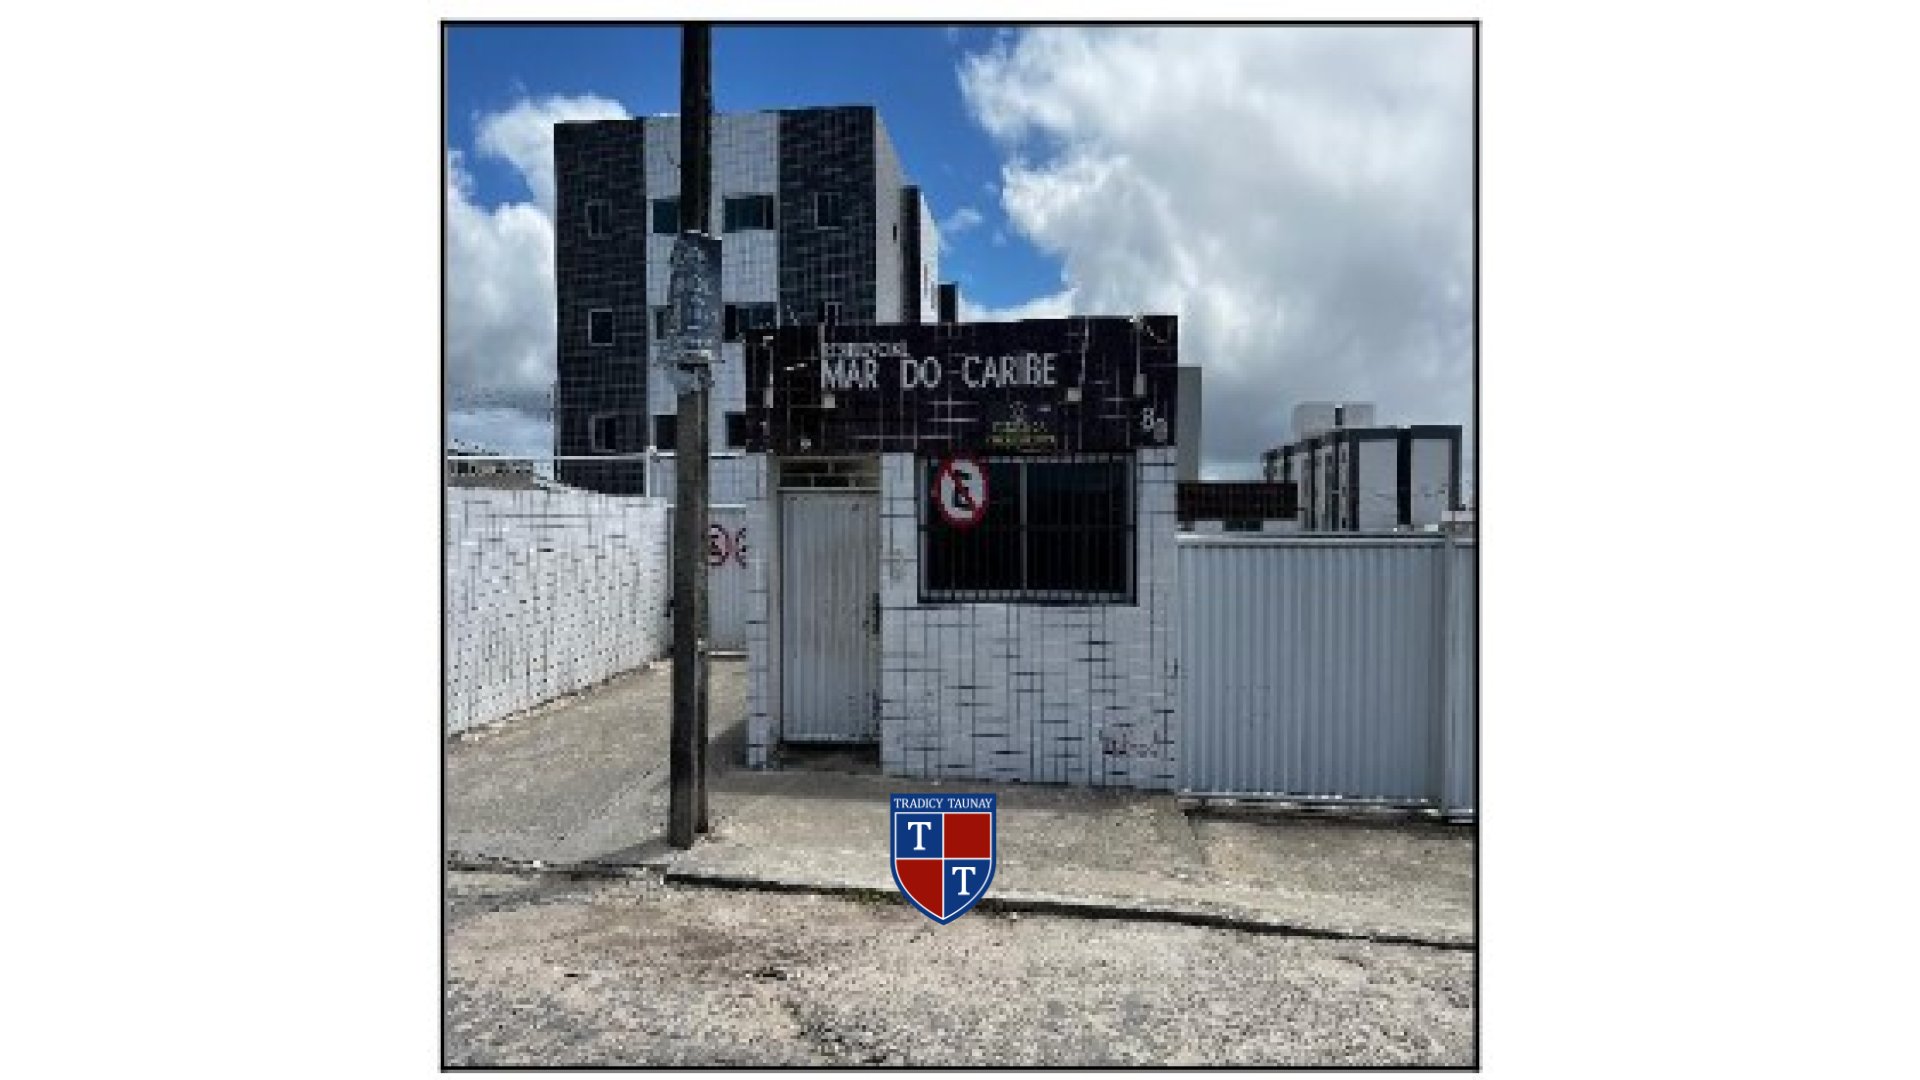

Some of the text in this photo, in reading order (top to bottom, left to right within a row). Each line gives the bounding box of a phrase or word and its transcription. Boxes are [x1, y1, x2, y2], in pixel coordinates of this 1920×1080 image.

[821, 353, 1057, 388] MAR DO CARIBE
